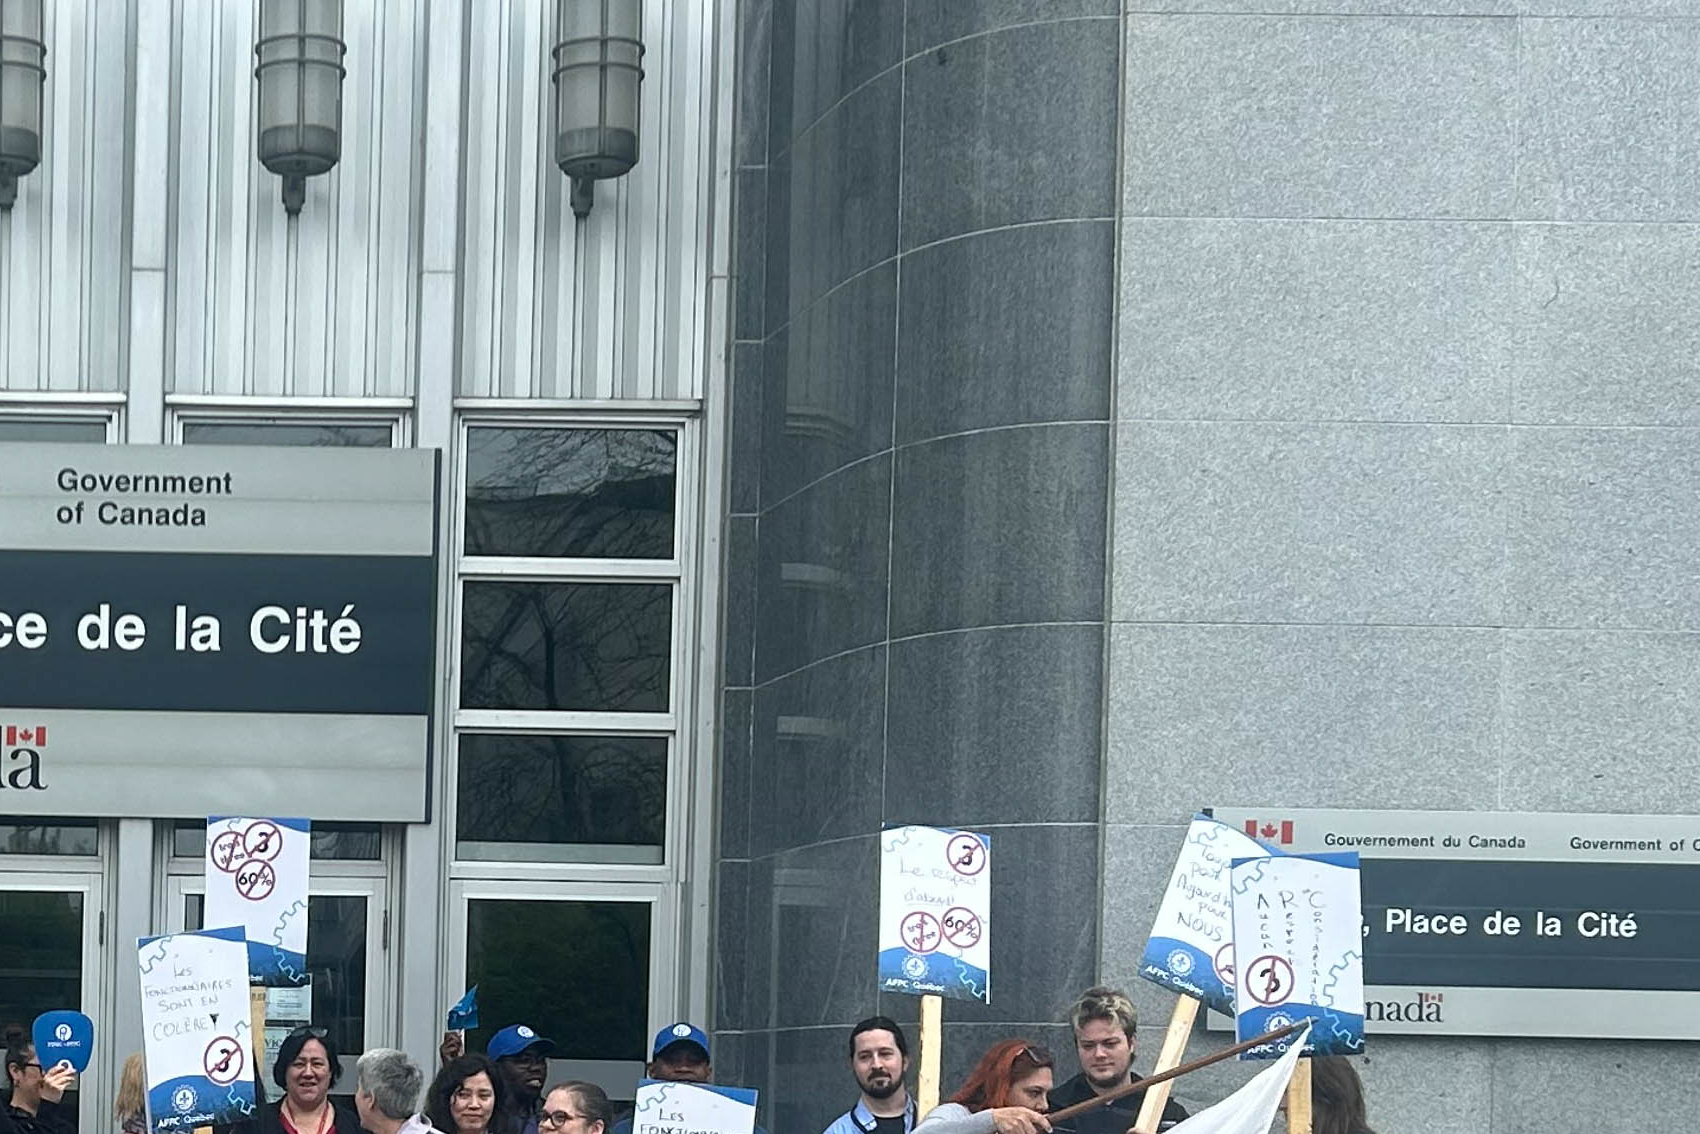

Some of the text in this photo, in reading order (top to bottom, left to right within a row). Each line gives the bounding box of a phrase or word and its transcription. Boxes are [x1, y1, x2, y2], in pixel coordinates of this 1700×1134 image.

[57, 469, 233, 495] Government
[57, 501, 206, 527] of Canada
[77, 604, 146, 650] de
[175, 606, 221, 651] la
[250, 605, 362, 654] Cité
[1324, 832, 1526, 850] Gouvernement du Canada
[1570, 837, 1661, 851] Government
[1669, 839, 1685, 851] of
[1386, 908, 1467, 936] Place
[1483, 911, 1521, 936] de
[1537, 912, 1561, 937] la
[1577, 912, 1638, 938] Cité
[1365, 992, 1444, 1024] nada
